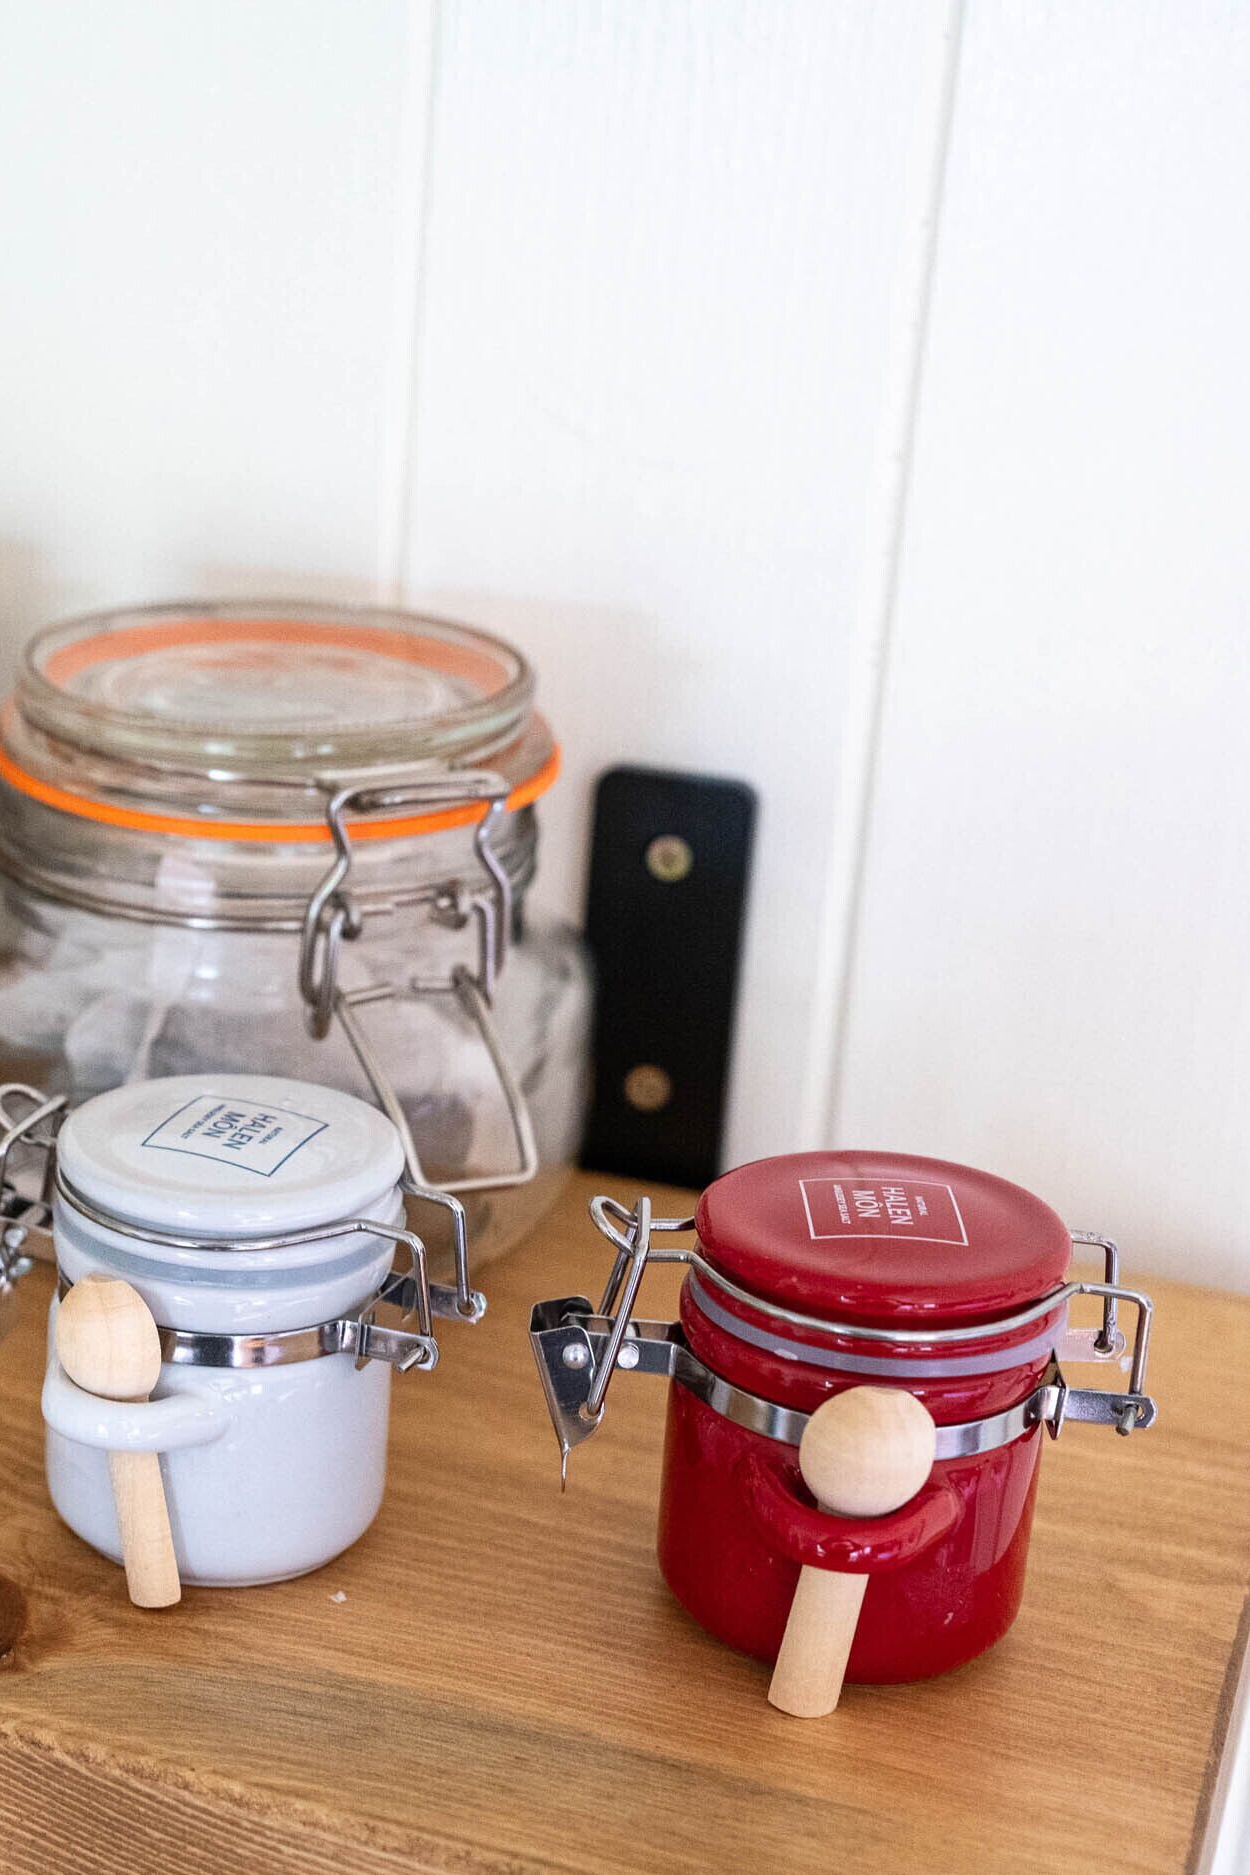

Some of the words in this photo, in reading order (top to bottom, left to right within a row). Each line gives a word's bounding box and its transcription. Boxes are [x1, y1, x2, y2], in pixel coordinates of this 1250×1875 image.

[201, 1111, 246, 1139] MÔN
[222, 1112, 278, 1150] HALEN
[852, 1190, 884, 1218] MÔN
[881, 1186, 914, 1225] HALEN
